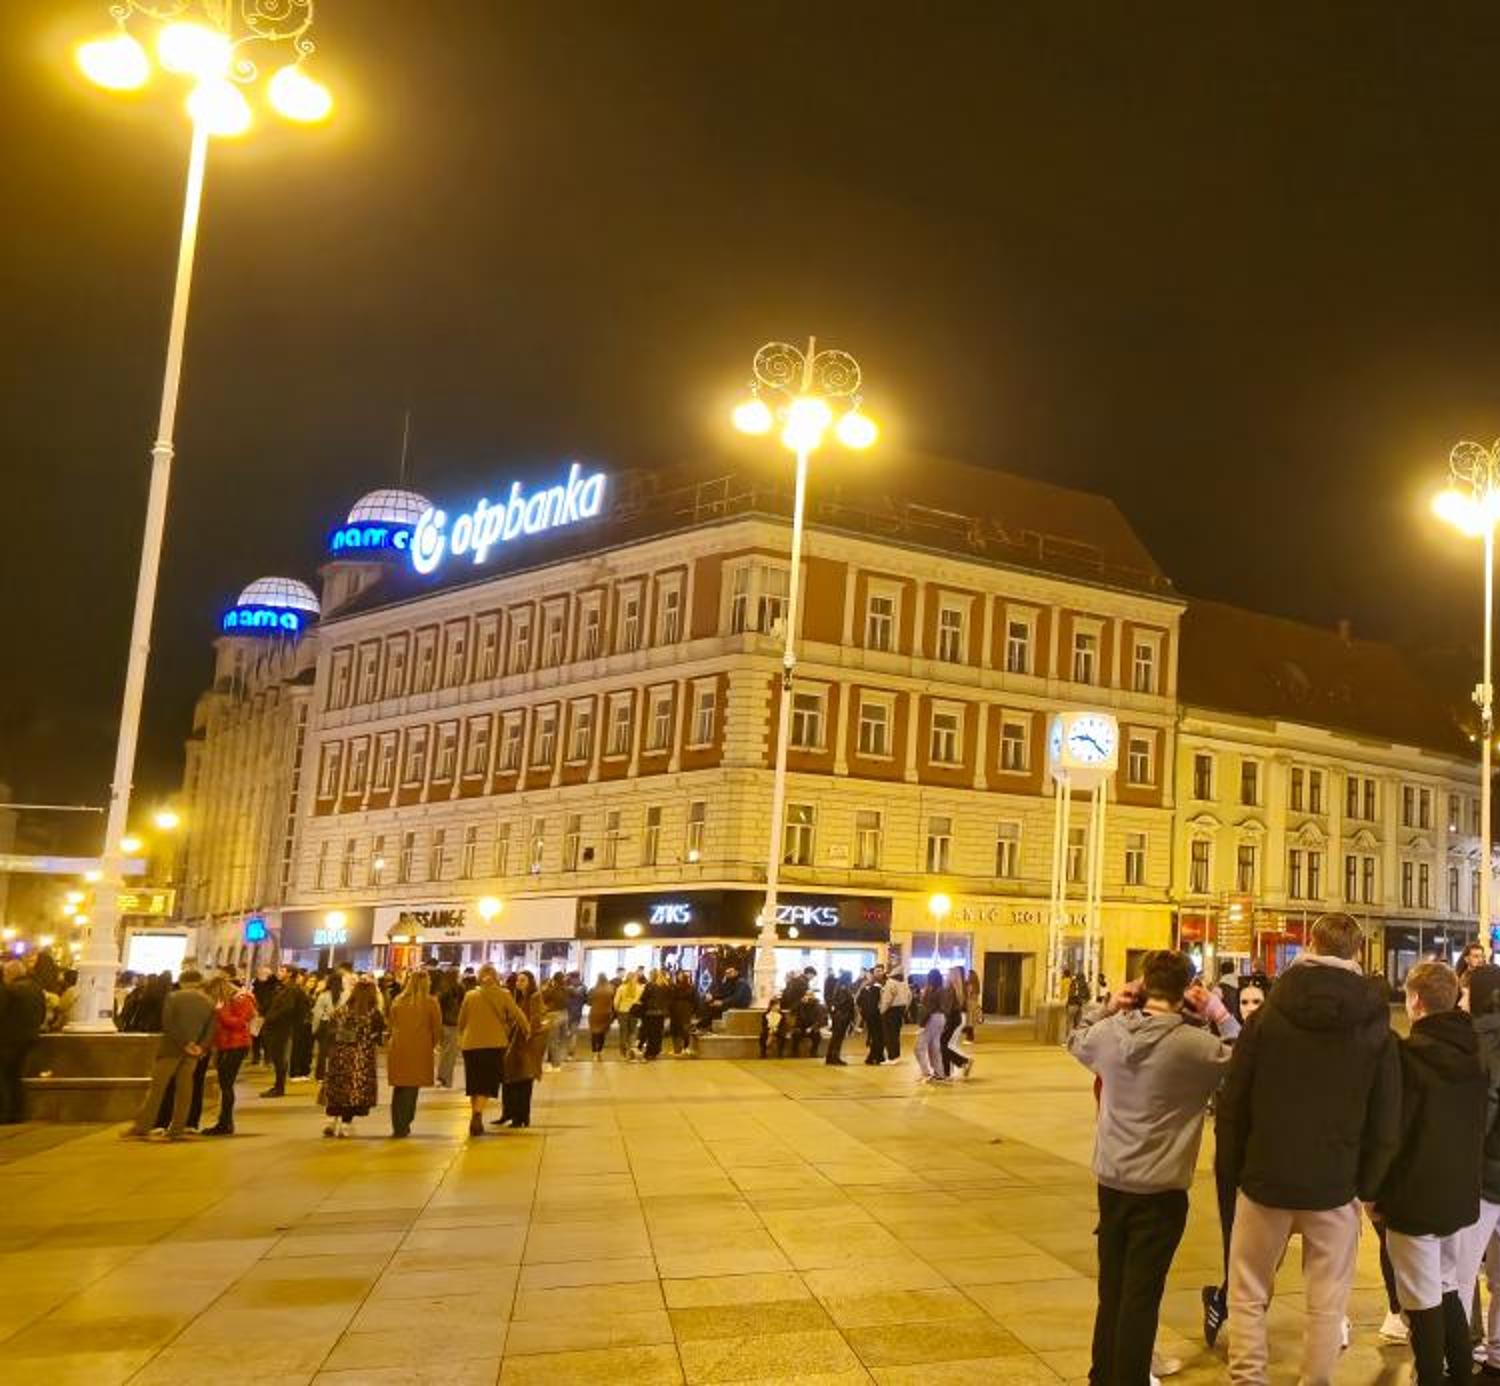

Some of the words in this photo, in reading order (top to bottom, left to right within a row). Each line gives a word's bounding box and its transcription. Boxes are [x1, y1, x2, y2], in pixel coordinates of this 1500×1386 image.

[399, 908, 466, 929] SSANGE
[649, 902, 691, 925] ZAKS
[775, 903, 839, 927] ZAKS
